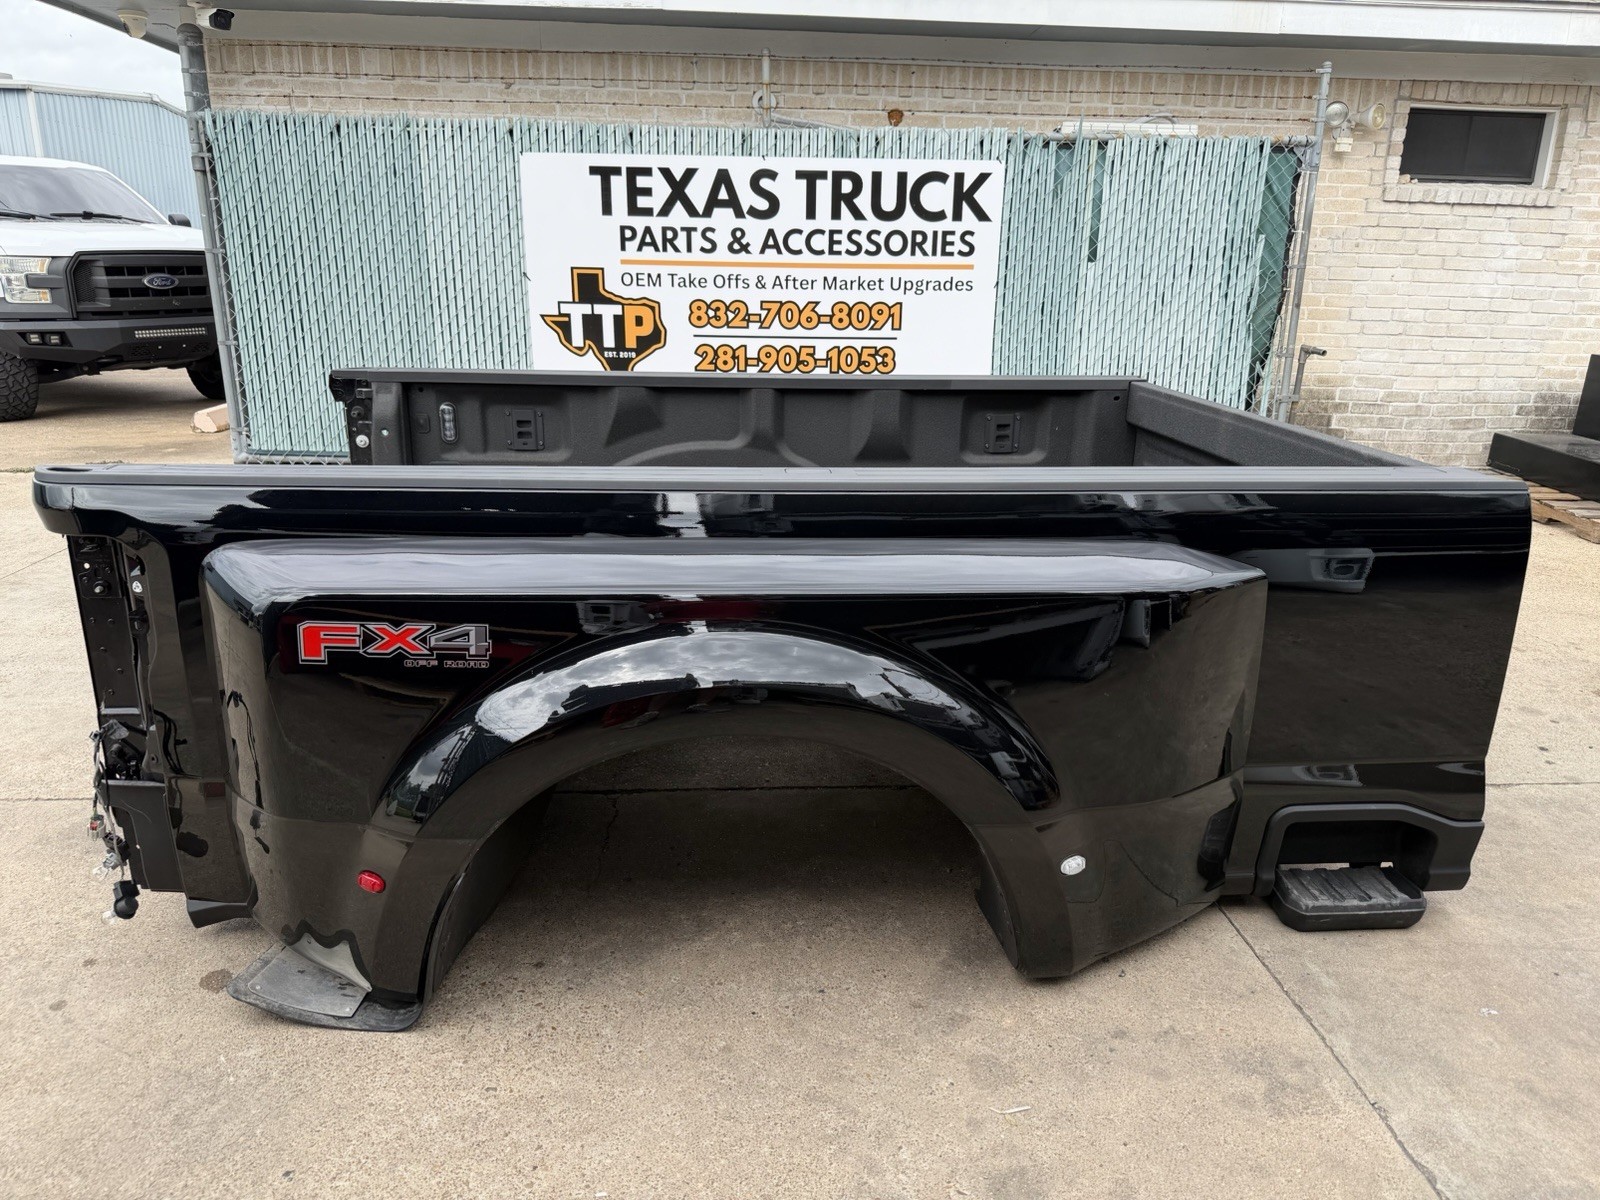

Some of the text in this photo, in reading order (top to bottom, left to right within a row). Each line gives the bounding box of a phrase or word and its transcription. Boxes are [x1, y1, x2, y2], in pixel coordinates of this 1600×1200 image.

[589, 166, 993, 222] TEXAS TRUCK
[619, 225, 976, 257] PARTS & ACCESSORIES
[621, 272, 973, 295] OEM Take Offs & After Market Upgrades
[558, 301, 655, 349] TTP
[688, 299, 903, 331] 832-706-8091
[619, 351, 637, 359] 2019
[694, 343, 896, 374] 281-905-1053
[297, 620, 492, 664] FX4
[404, 659, 489, 668] OFF ROAD
